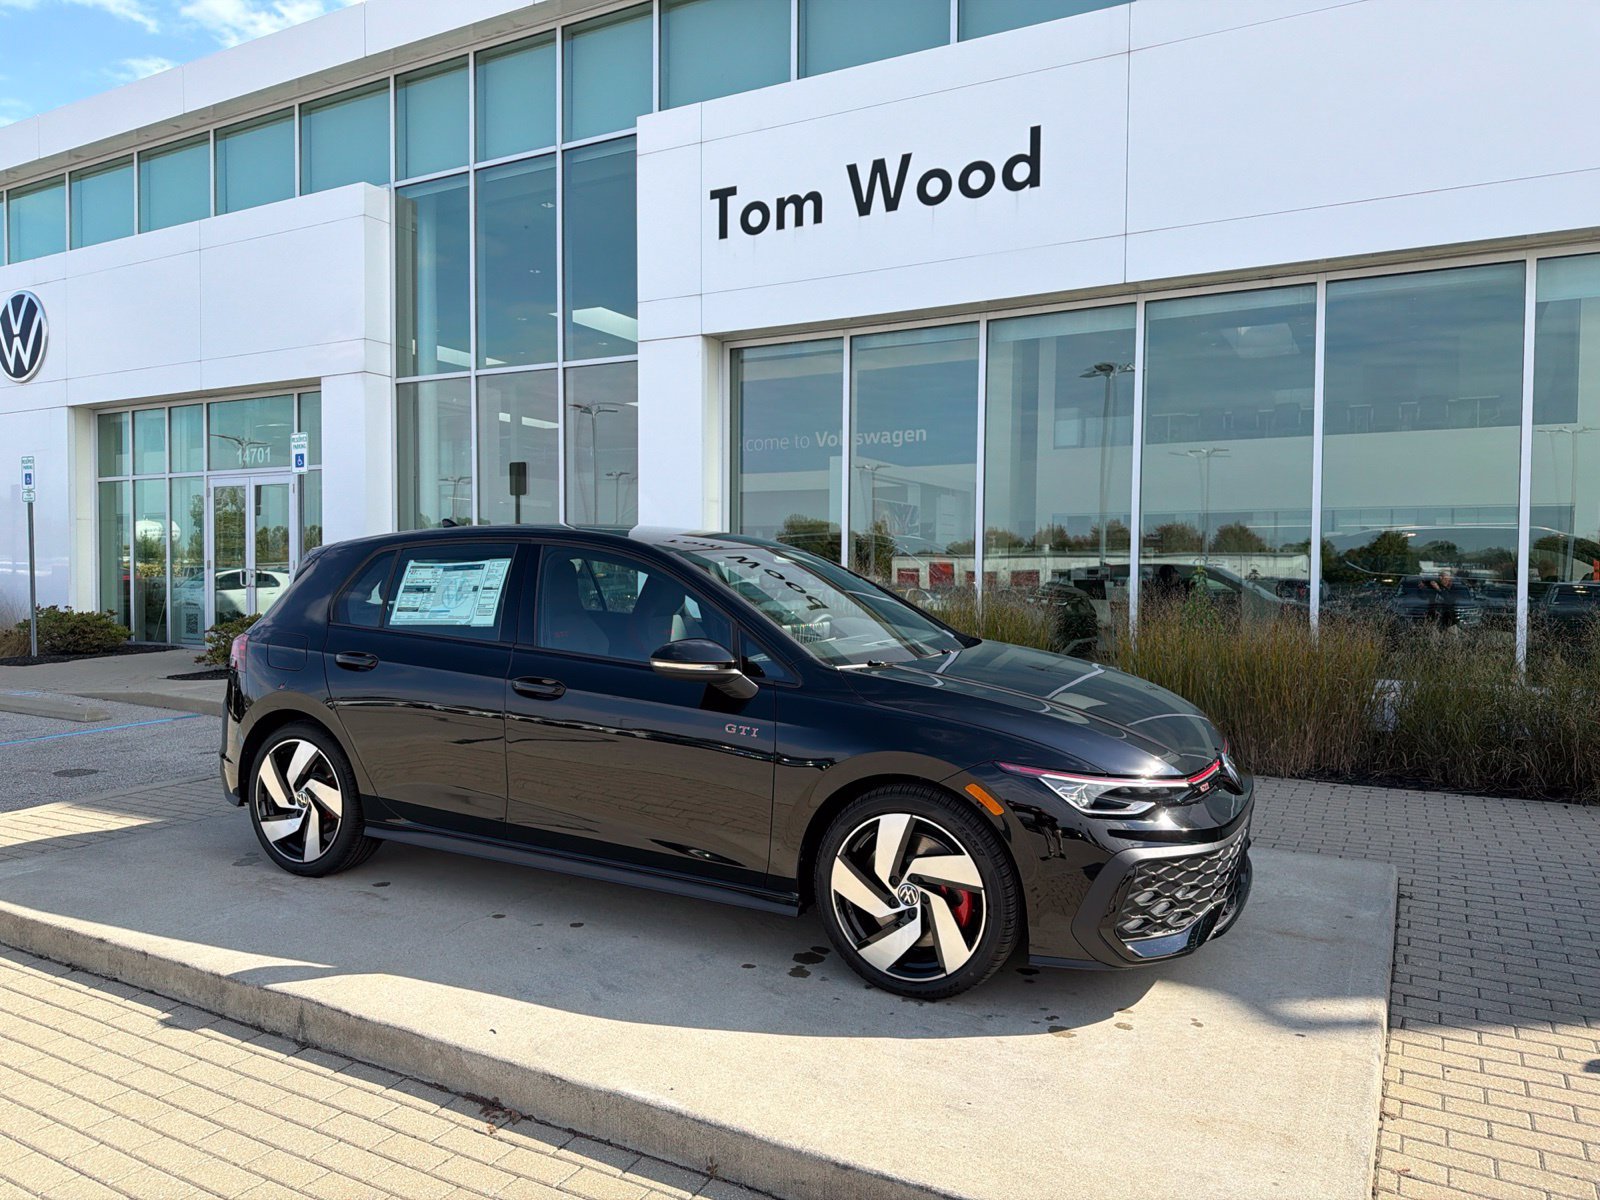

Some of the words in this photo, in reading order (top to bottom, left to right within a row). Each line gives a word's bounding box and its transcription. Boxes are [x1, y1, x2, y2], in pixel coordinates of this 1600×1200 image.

[709, 185, 823, 240] Tom
[846, 124, 1042, 218] Wood
[794, 434, 810, 449] to
[815, 427, 928, 448] Volswagen
[236, 446, 272, 466] 14701
[724, 723, 760, 738] GTI
